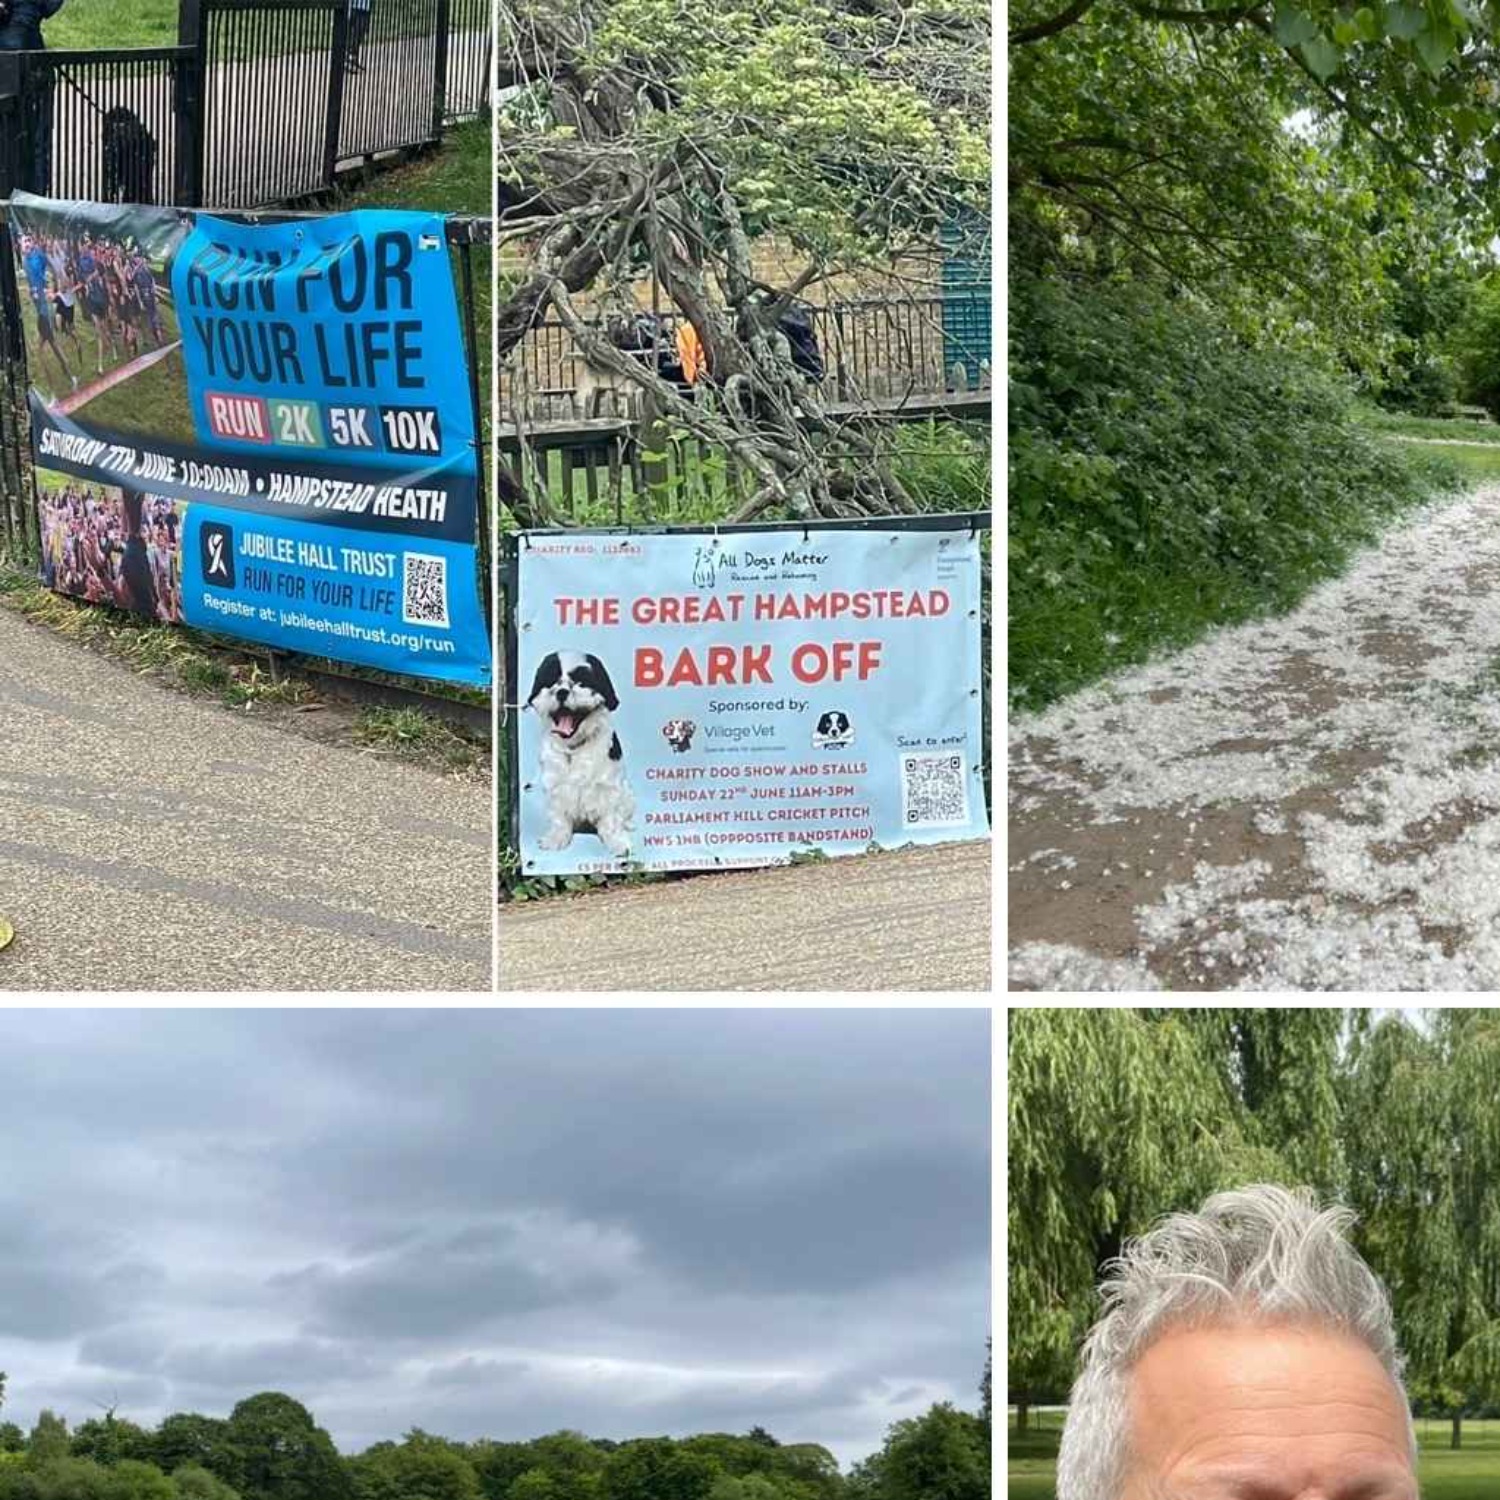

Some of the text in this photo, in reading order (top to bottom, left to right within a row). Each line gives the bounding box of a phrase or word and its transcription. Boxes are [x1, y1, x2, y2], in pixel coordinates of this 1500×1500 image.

[193, 316, 426, 389] YOUR LIFE
[210, 397, 440, 451] RUN 2K 5K 10K
[39, 428, 448, 522] SATURDAY 7TH JUNE 10:00AM HAMPSTEAD HEATH
[239, 533, 397, 579] JUBILEE HALL TRUST
[719, 551, 829, 570] All Dogs Matter
[243, 567, 397, 616] RUN FOR YOUR LIFE
[555, 590, 950, 625] THE GREAT HAMPSTEAD
[203, 593, 455, 653] Register at: jubileehalltrust.org/run
[634, 642, 883, 688] BARK OFF
[709, 698, 809, 714] Sponsored by:
[704, 725, 775, 741] Village Vet
[646, 763, 868, 780] CHARITY DOG SHOW AND STALLS
[660, 788, 715, 801] SUNDAY
[750, 786, 786, 799] JUNE
[789, 785, 855, 798] 11AM-3PM
[645, 806, 870, 825] PARLIAMENT HILL CRICKET PITCH
[788, 825, 874, 843] BANDSTAND)
